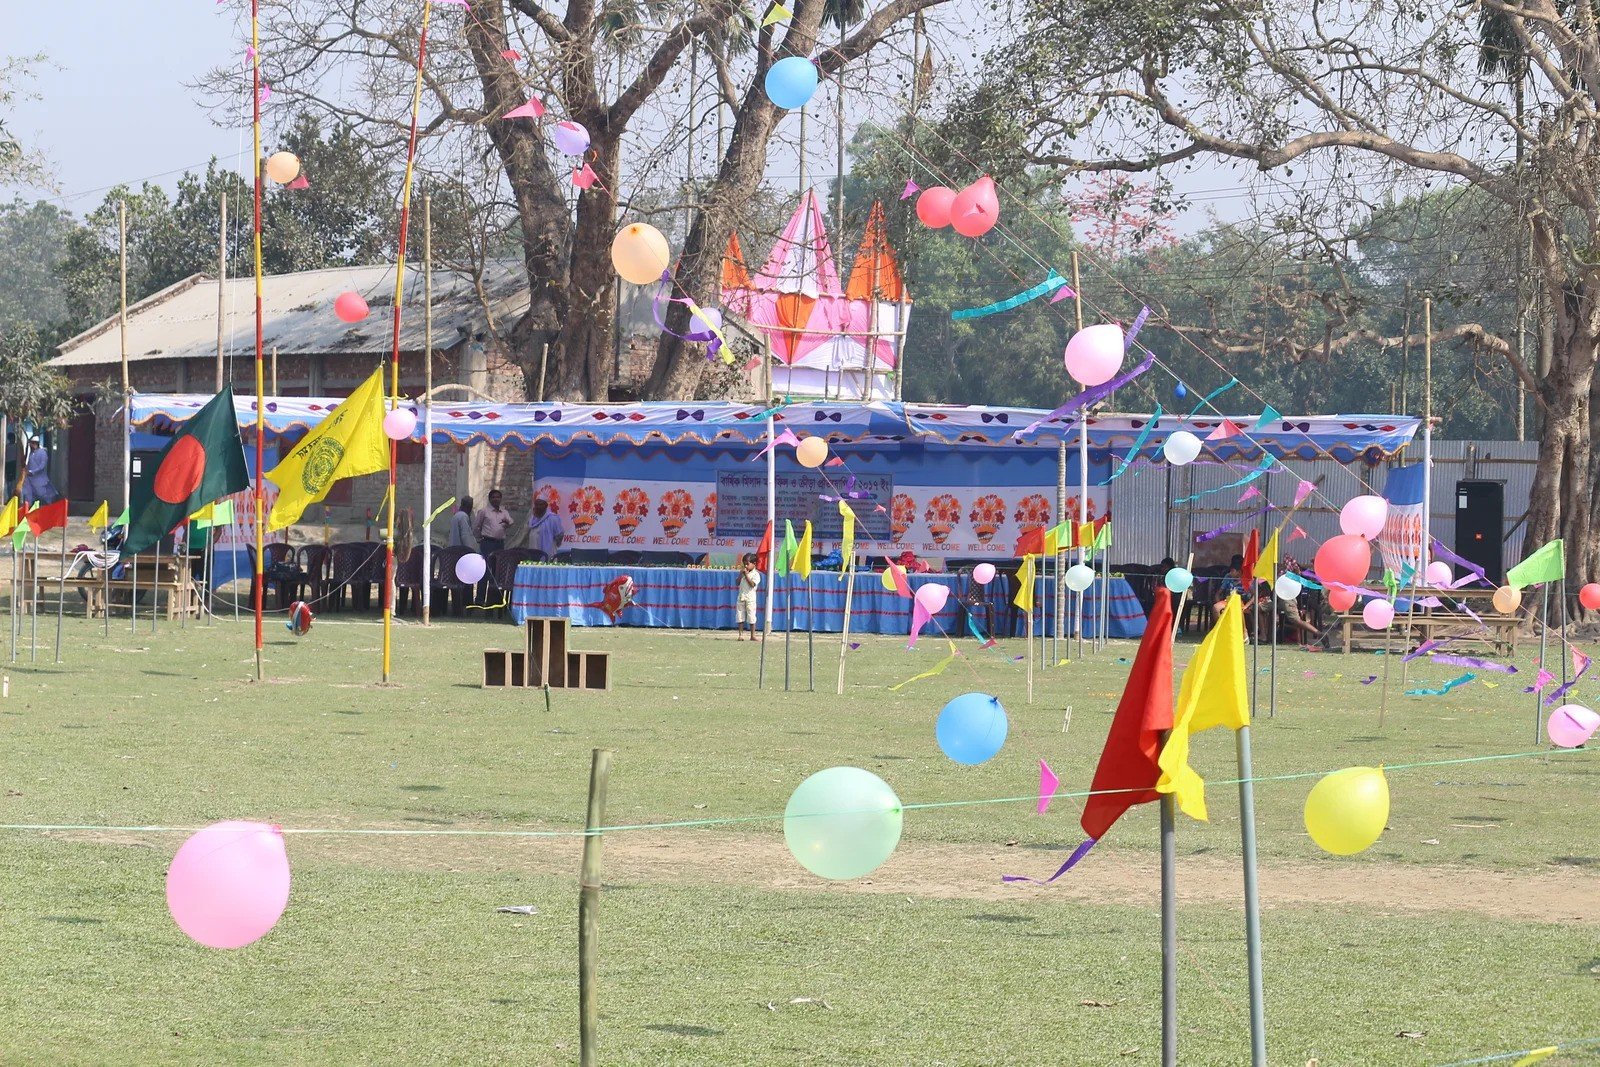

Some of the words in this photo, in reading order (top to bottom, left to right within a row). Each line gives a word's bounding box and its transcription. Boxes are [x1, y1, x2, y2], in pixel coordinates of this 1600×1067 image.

[563, 535, 581, 543] WELL
[582, 535, 601, 544] COME
[608, 536, 625, 544] WELL
[627, 537, 646, 545] COME
[653, 537, 669, 545] WELL
[671, 537, 690, 546] COME
[697, 537, 714, 546] WELL
[716, 538, 735, 547] COME
[877, 542, 894, 550] WELL
[896, 542, 915, 550] COME
[922, 543, 939, 551] WELL
[941, 543, 960, 551] COME
[968, 543, 985, 551] WELL
[987, 544, 1005, 552] COME
